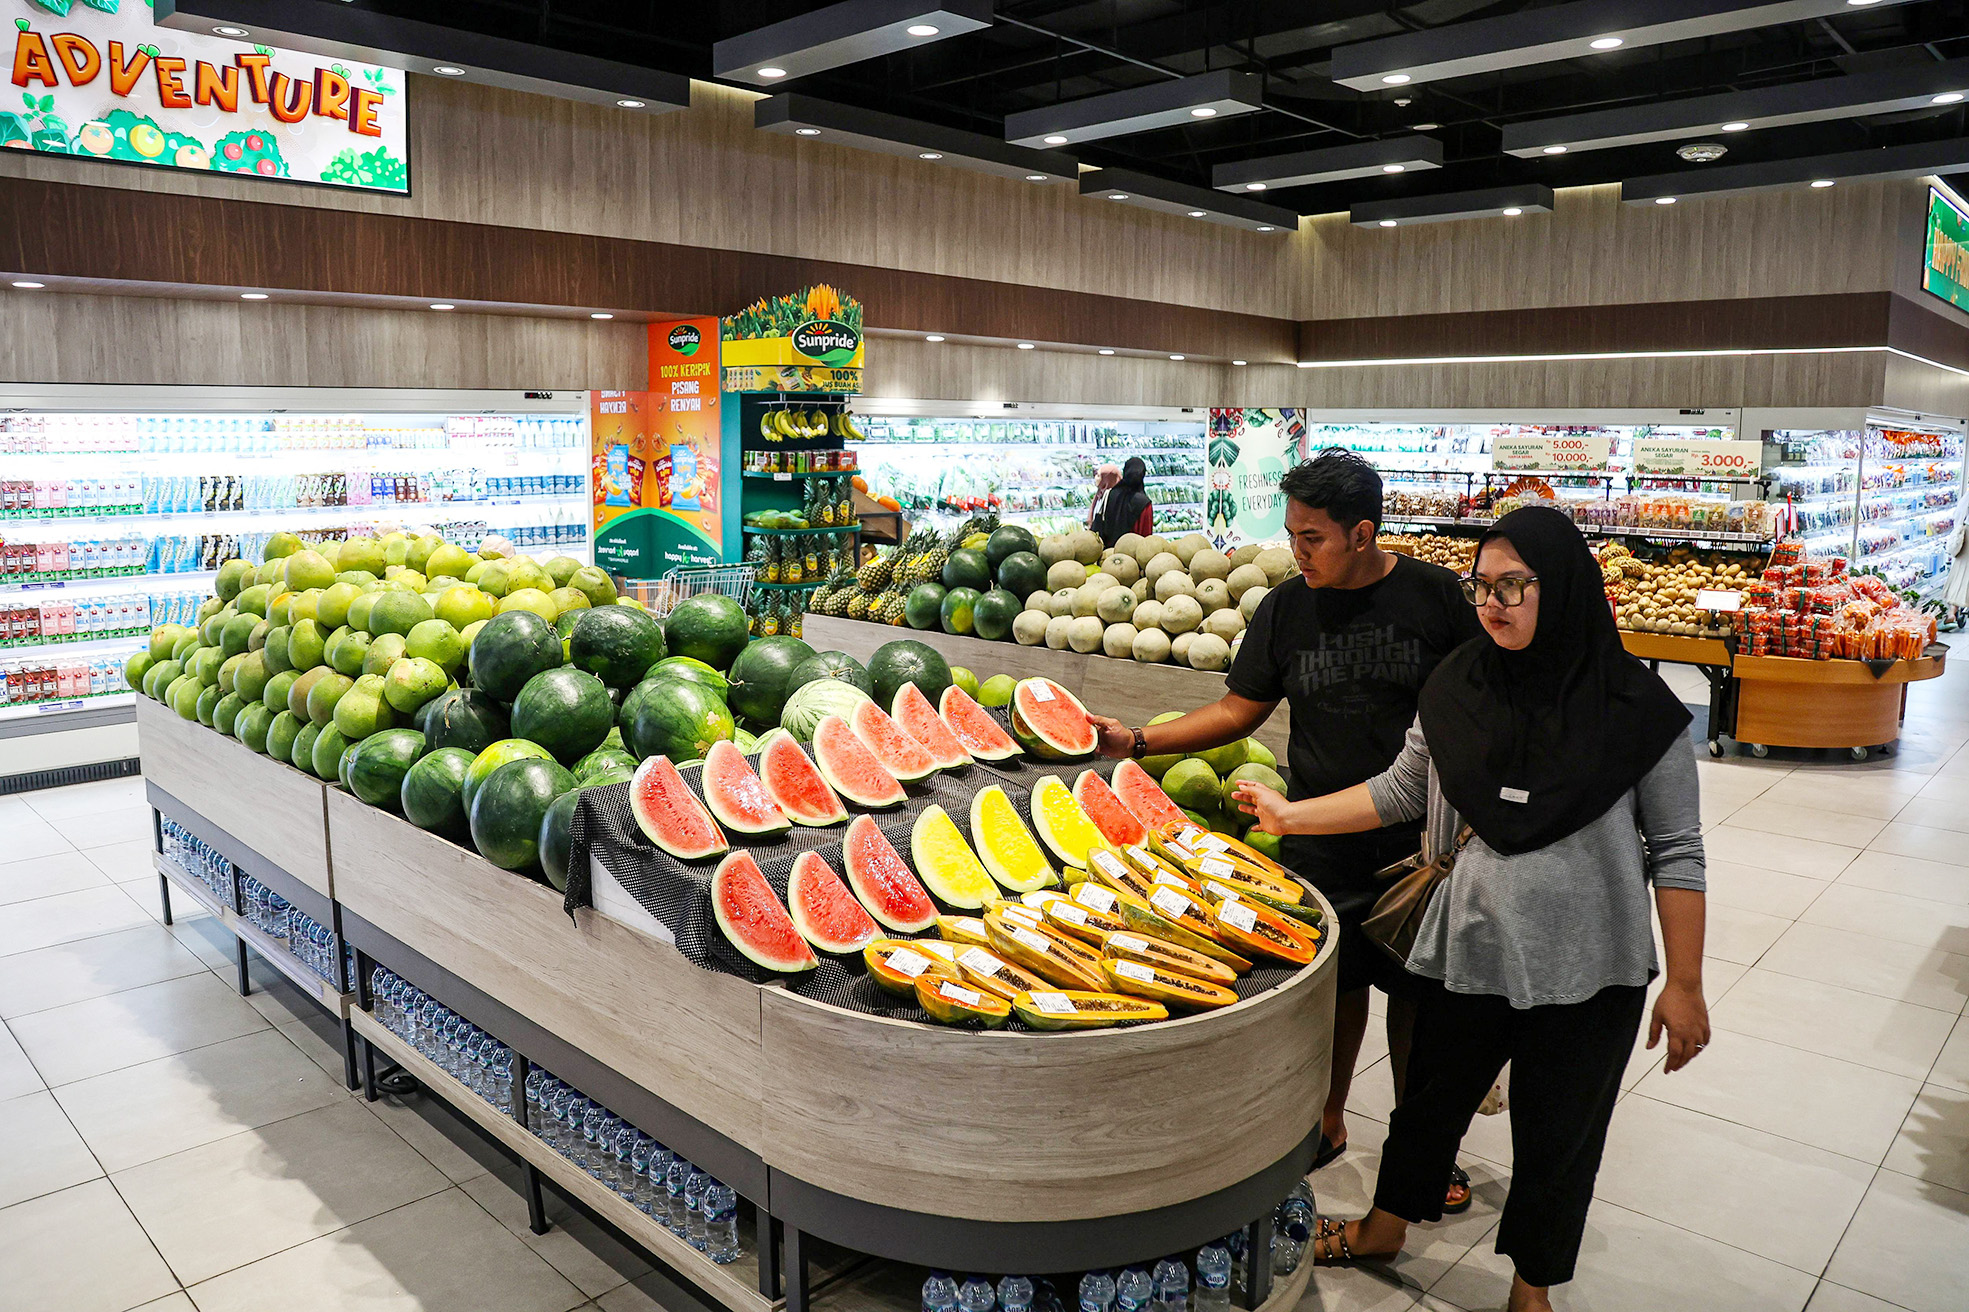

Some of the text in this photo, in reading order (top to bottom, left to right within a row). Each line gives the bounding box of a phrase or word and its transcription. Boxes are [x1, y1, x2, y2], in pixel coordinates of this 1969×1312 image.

[11, 30, 384, 138] ADVENTURE
[669, 332, 699, 346] Sunpride
[798, 332, 854, 352] Sunpride
[660, 362, 711, 378] 100% KERIPIK
[830, 370, 858, 381] 100%
[671, 380, 700, 395] PISANG
[670, 398, 701, 412] RENYAH
[1552, 440, 1589, 450] 5.000,-
[1552, 453, 1593, 463] 10.000,-
[1701, 454, 1754, 469] 3.000,-
[1242, 493, 1282, 511] EVERYDAY
[1296, 638, 1421, 676] THROUGH
[1299, 662, 1419, 697] THE PAIN
